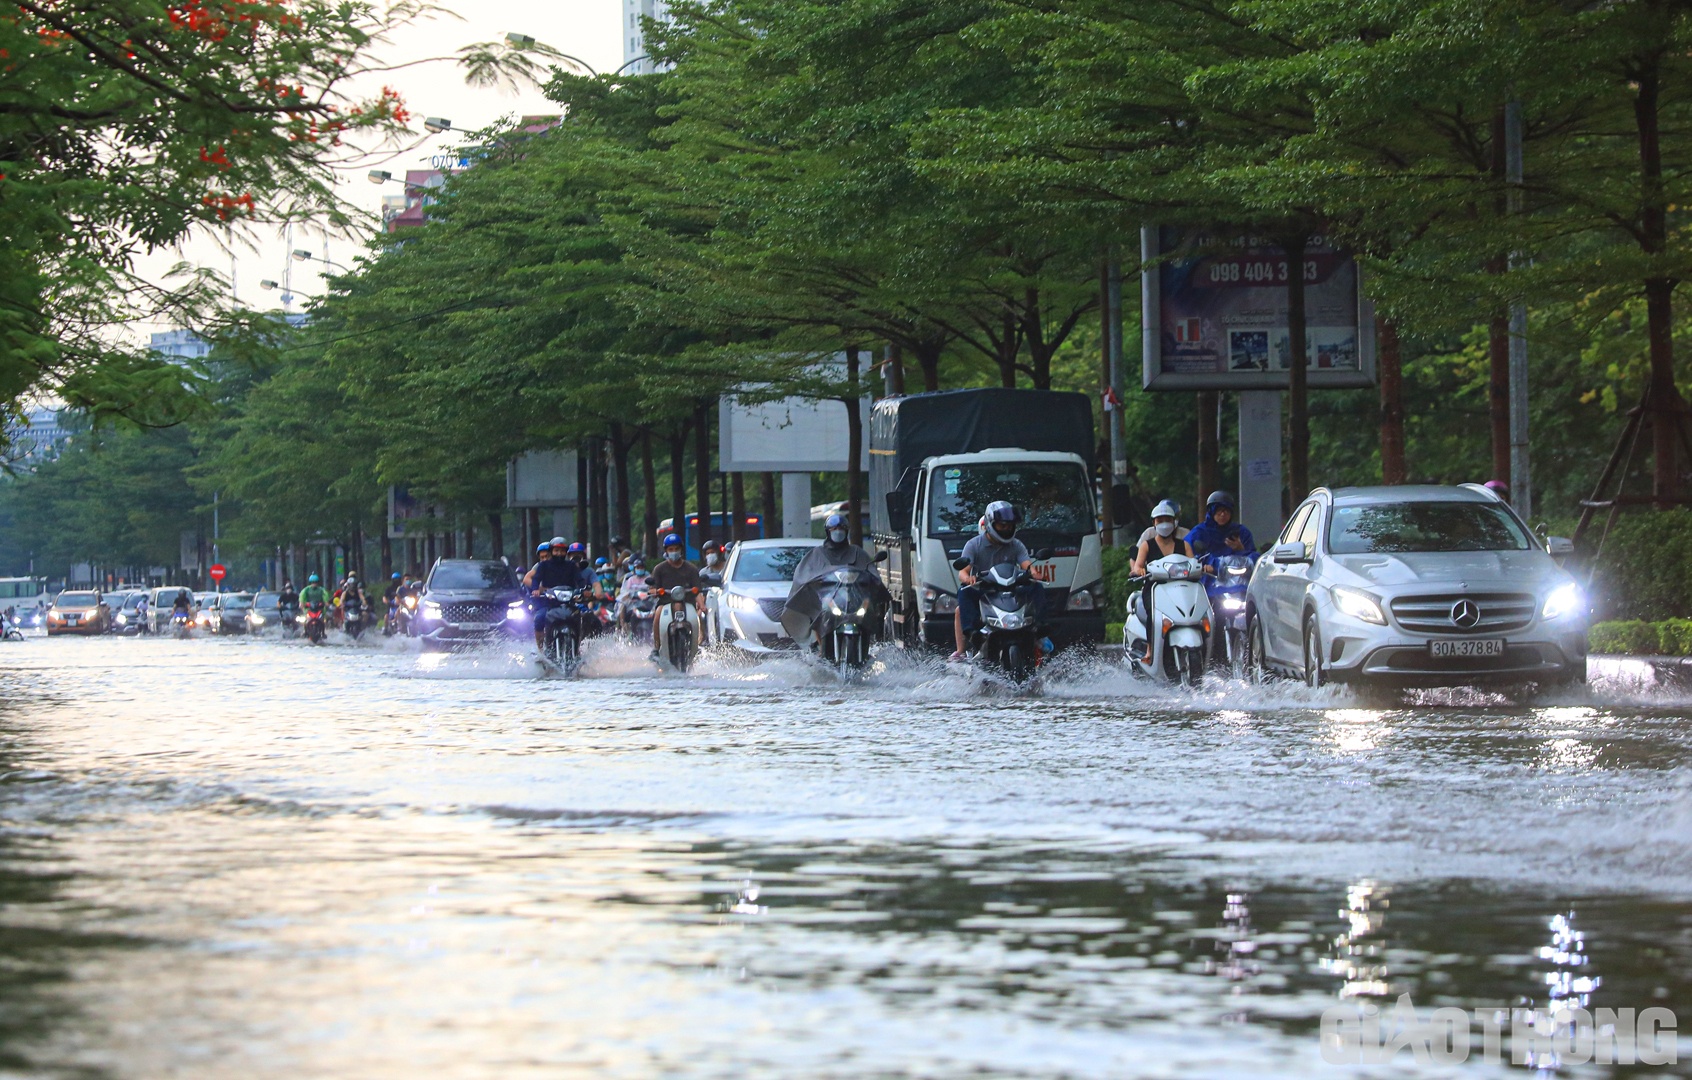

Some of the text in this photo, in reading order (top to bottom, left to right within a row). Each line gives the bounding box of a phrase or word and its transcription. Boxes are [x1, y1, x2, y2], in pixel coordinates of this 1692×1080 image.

[1210, 261, 1317, 282] 098 404 33
